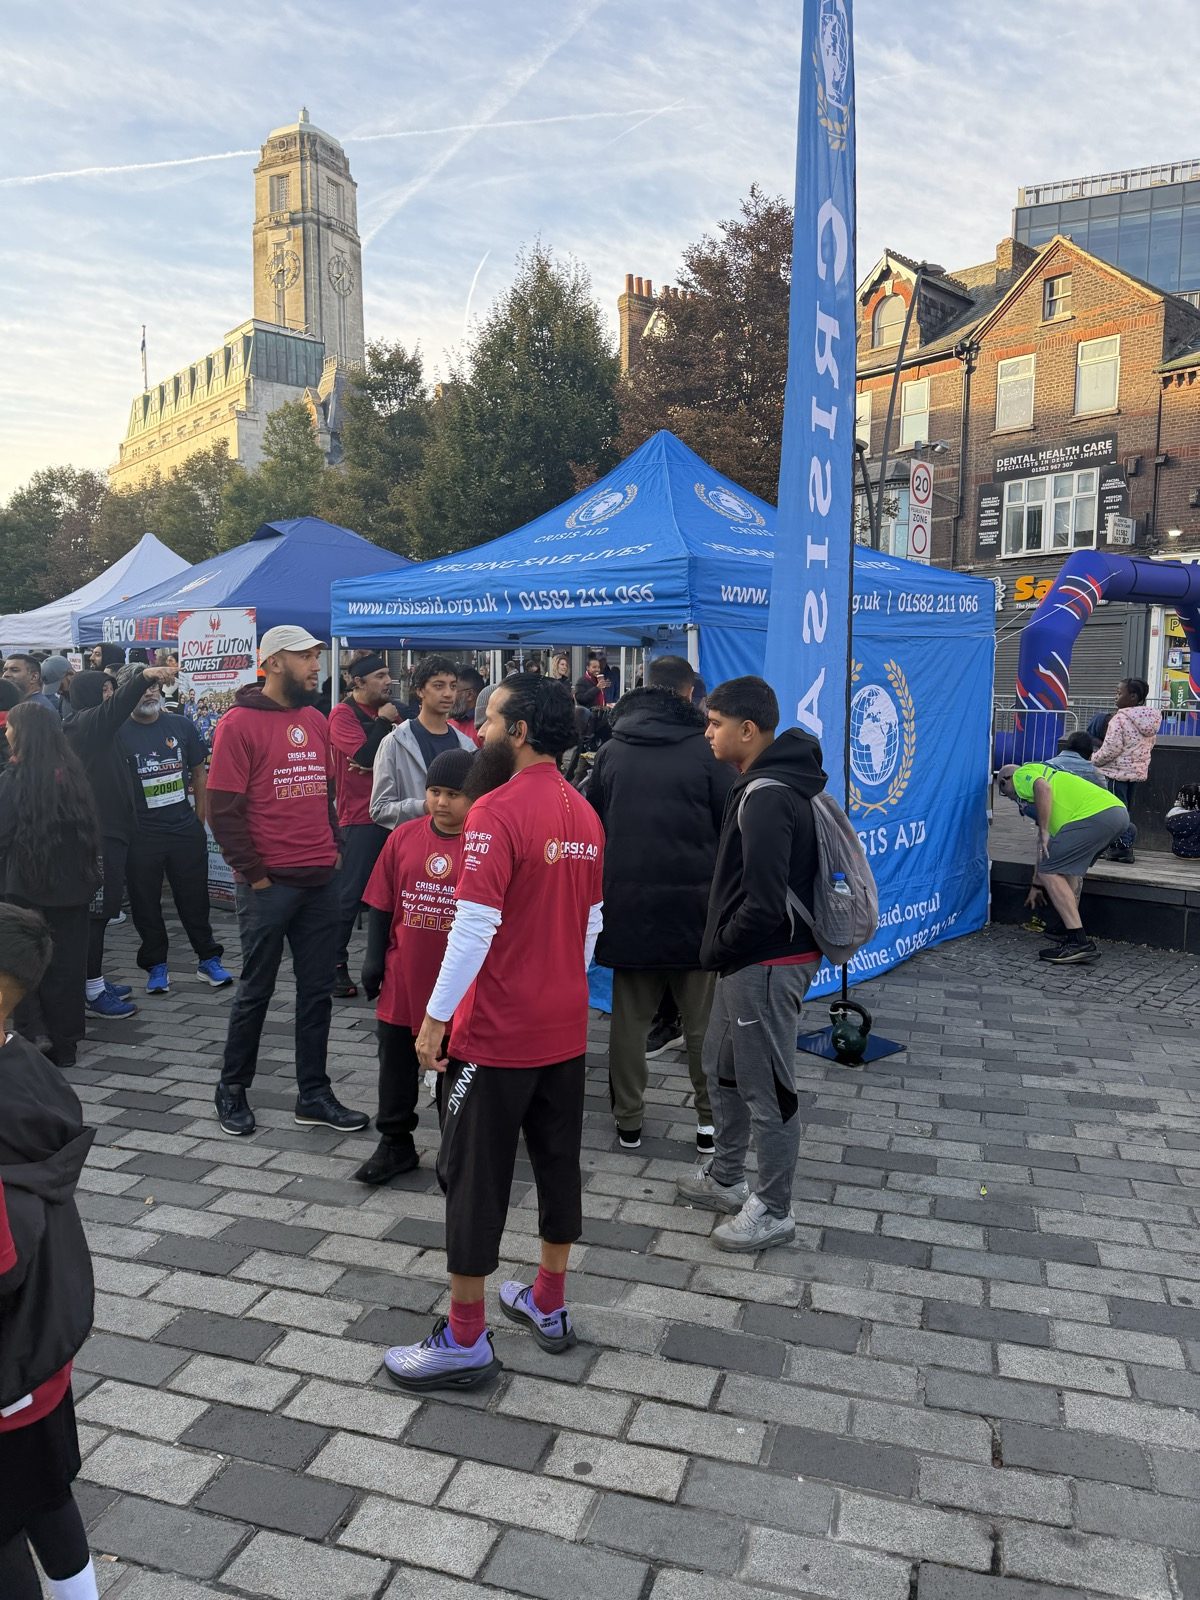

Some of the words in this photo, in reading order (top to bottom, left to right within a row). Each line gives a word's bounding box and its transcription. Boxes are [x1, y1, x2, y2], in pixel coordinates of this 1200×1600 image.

[996, 454, 1035, 467] DENTAL
[1039, 446, 1079, 461] HEALTH
[1083, 440, 1112, 453] CARE
[996, 461, 1038, 472] SPECIALISTS
[1051, 454, 1077, 464] DENTAL
[1080, 448, 1112, 459] IMPLANT
[1031, 464, 1049, 473] 01582
[915, 475, 928, 493] 20
[913, 513, 928, 524] ZONE
[534, 530, 580, 543] CRISIS
[580, 527, 609, 538] AID
[425, 559, 518, 573] HELPING
[517, 553, 580, 567] SAVE
[579, 543, 653, 560] LIVES
[348, 593, 498, 616] www.crisisaid.org.uk
[518, 589, 575, 611] 01582
[576, 586, 613, 607] 211
[614, 583, 655, 604] 066
[898, 592, 934, 613] 01582
[935, 594, 956, 613] 211
[959, 595, 978, 613] 066
[217, 636, 253, 654] LUTON
[184, 658, 222, 672] RUNFEST
[273, 766, 292, 775] Every
[273, 775, 293, 785] Every
[294, 774, 314, 782] Cause
[153, 780, 177, 796] 2090
[894, 820, 926, 850] AID
[560, 841, 584, 855] CRSIS
[586, 843, 598, 857] AD
[415, 881, 440, 891] CRISIS
[442, 885, 456, 893] AID
[418, 893, 435, 902] Mile
[417, 903, 441, 914] Cause
